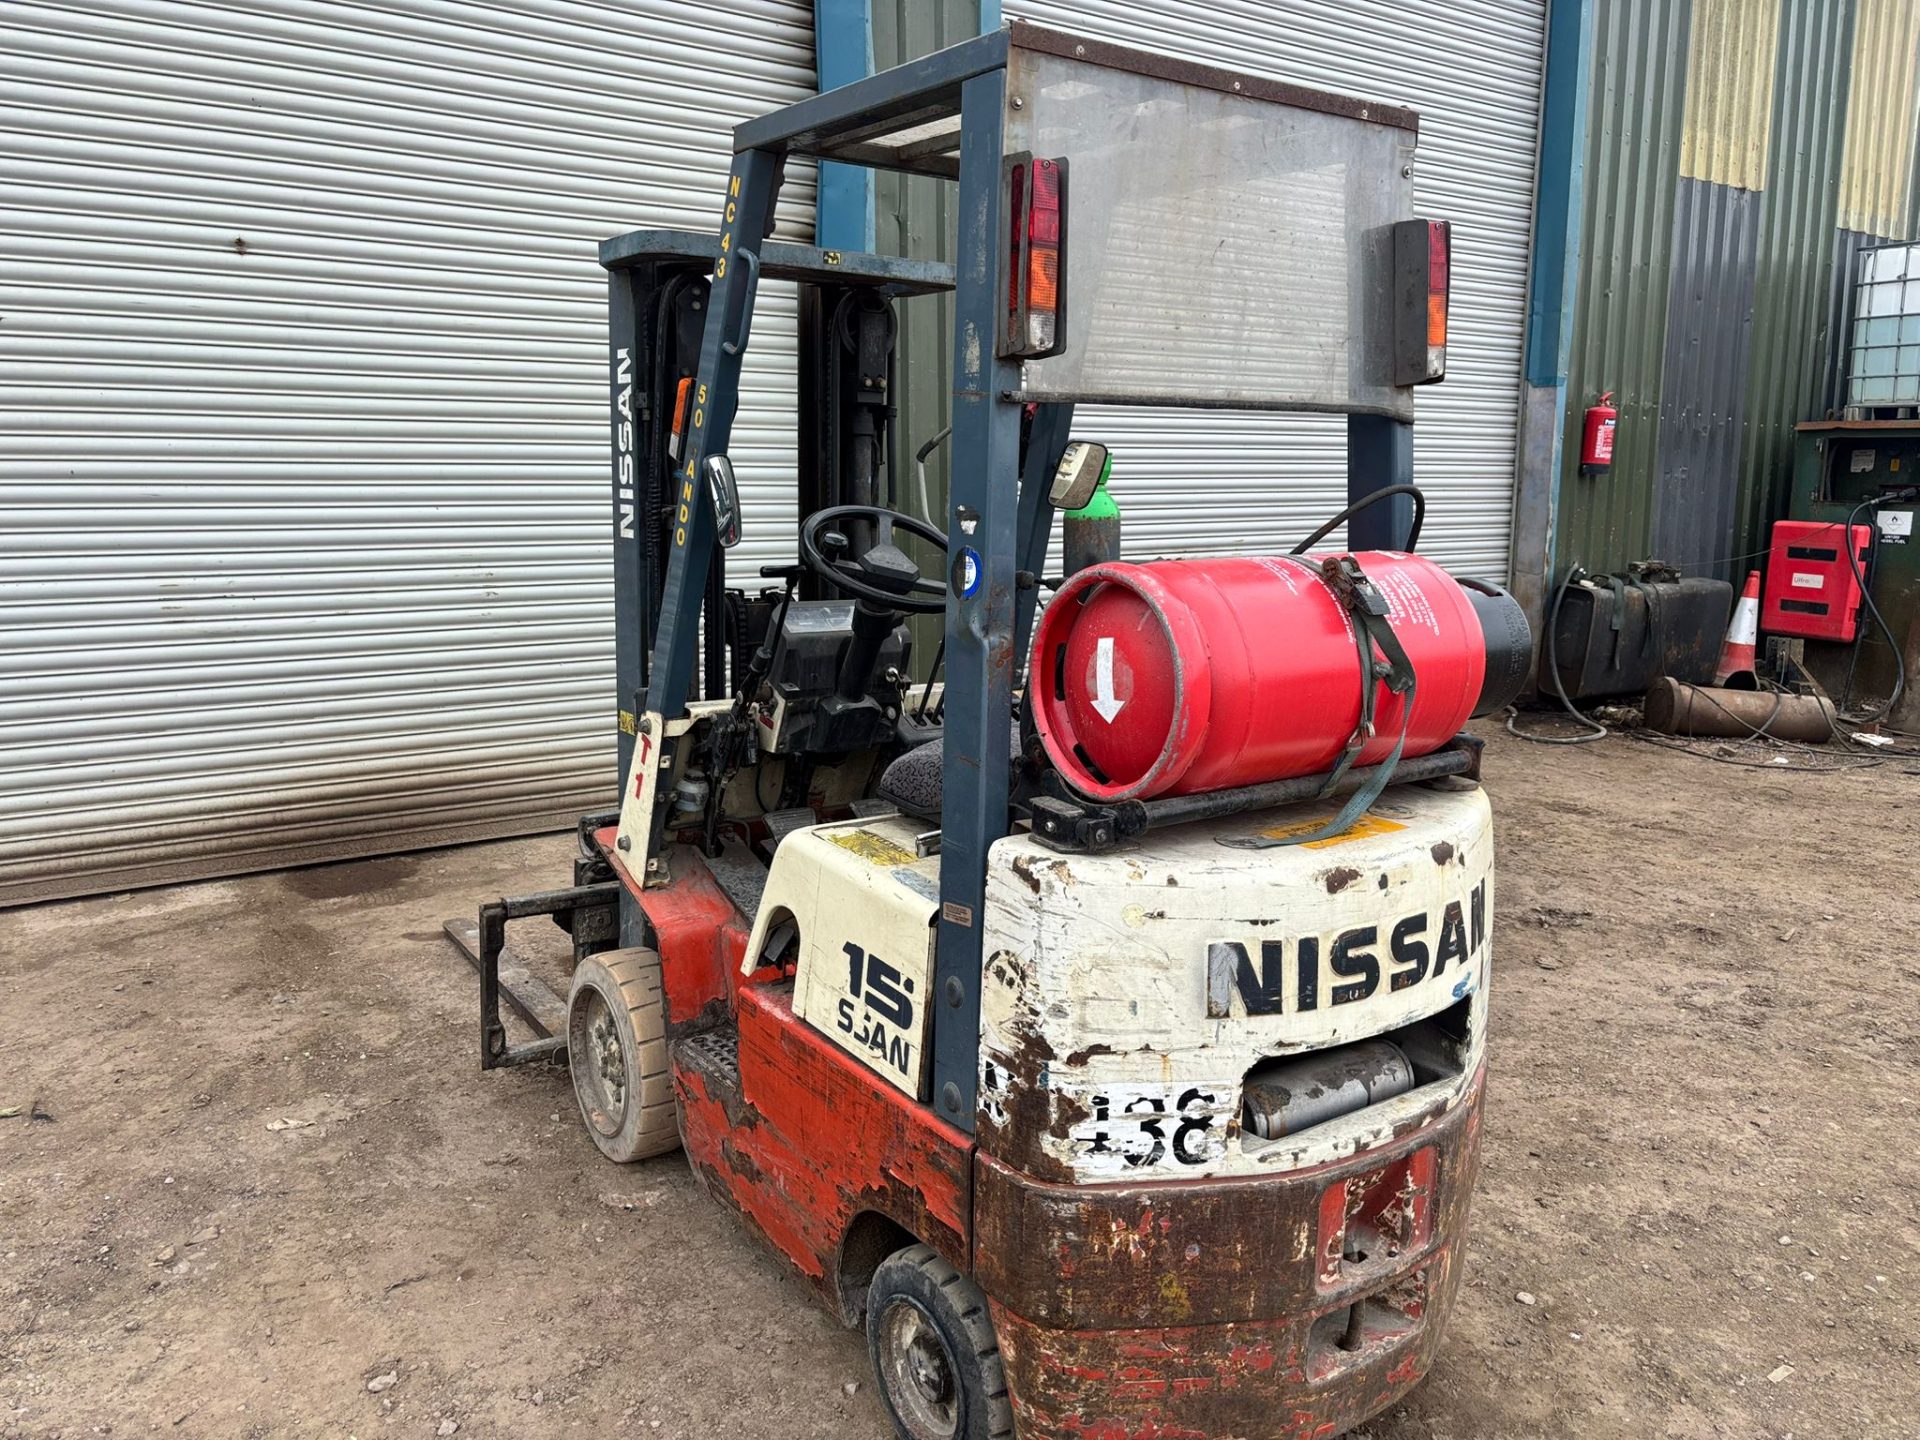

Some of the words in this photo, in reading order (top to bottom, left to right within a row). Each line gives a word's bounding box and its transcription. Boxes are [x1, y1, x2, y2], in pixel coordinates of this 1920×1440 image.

[615, 346, 634, 540] NISSAN
[1379, 579, 1406, 618] DANGER
[1207, 878, 1486, 1019] NISSAN
